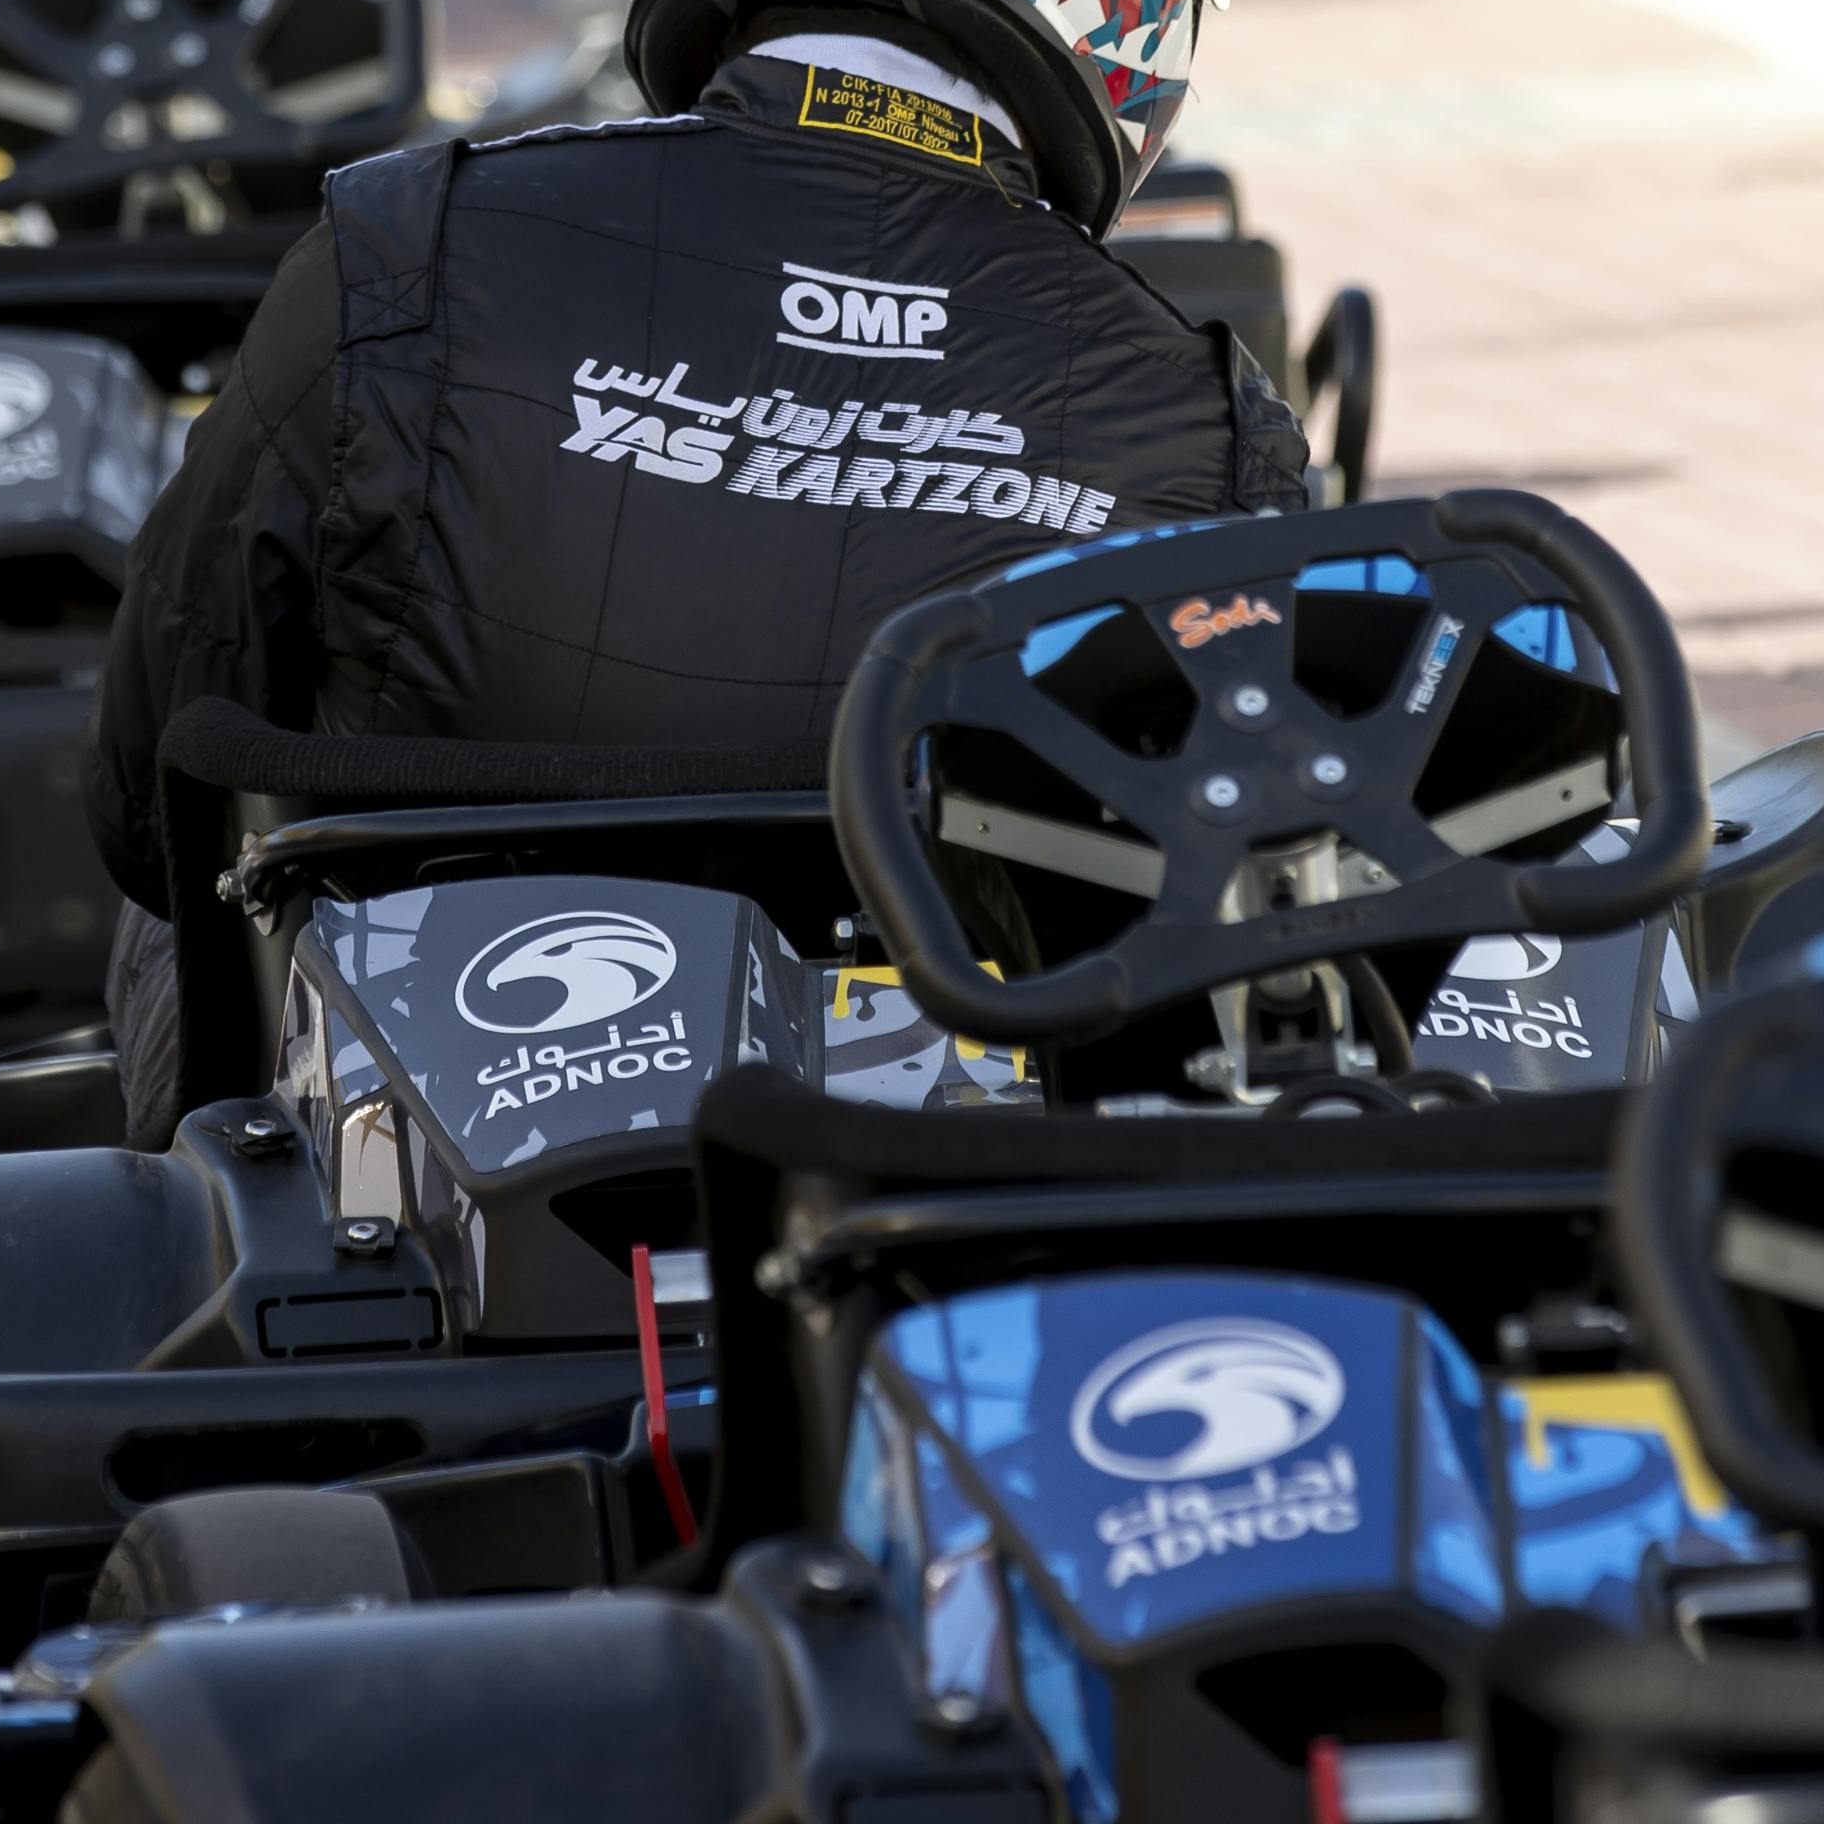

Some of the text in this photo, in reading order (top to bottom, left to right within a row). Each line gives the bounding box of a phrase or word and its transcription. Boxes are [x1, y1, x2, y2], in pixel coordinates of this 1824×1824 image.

[815, 87, 828, 104] N
[888, 104, 916, 122] OMP
[921, 113, 959, 143] Niveau
[963, 131, 970, 143] 1
[780, 281, 948, 345] OMP
[573, 358, 749, 428] ياس
[857, 400, 1025, 455] كارت
[559, 393, 1117, 535] YAS KARTZONE
[1404, 613, 1465, 714] TEKNEEX
[477, 1010, 686, 1086] أدنوك
[1416, 1010, 1593, 1059] DNOC
[485, 1046, 693, 1120] ADNOC
[1106, 1498, 1362, 1590] ADNOC
